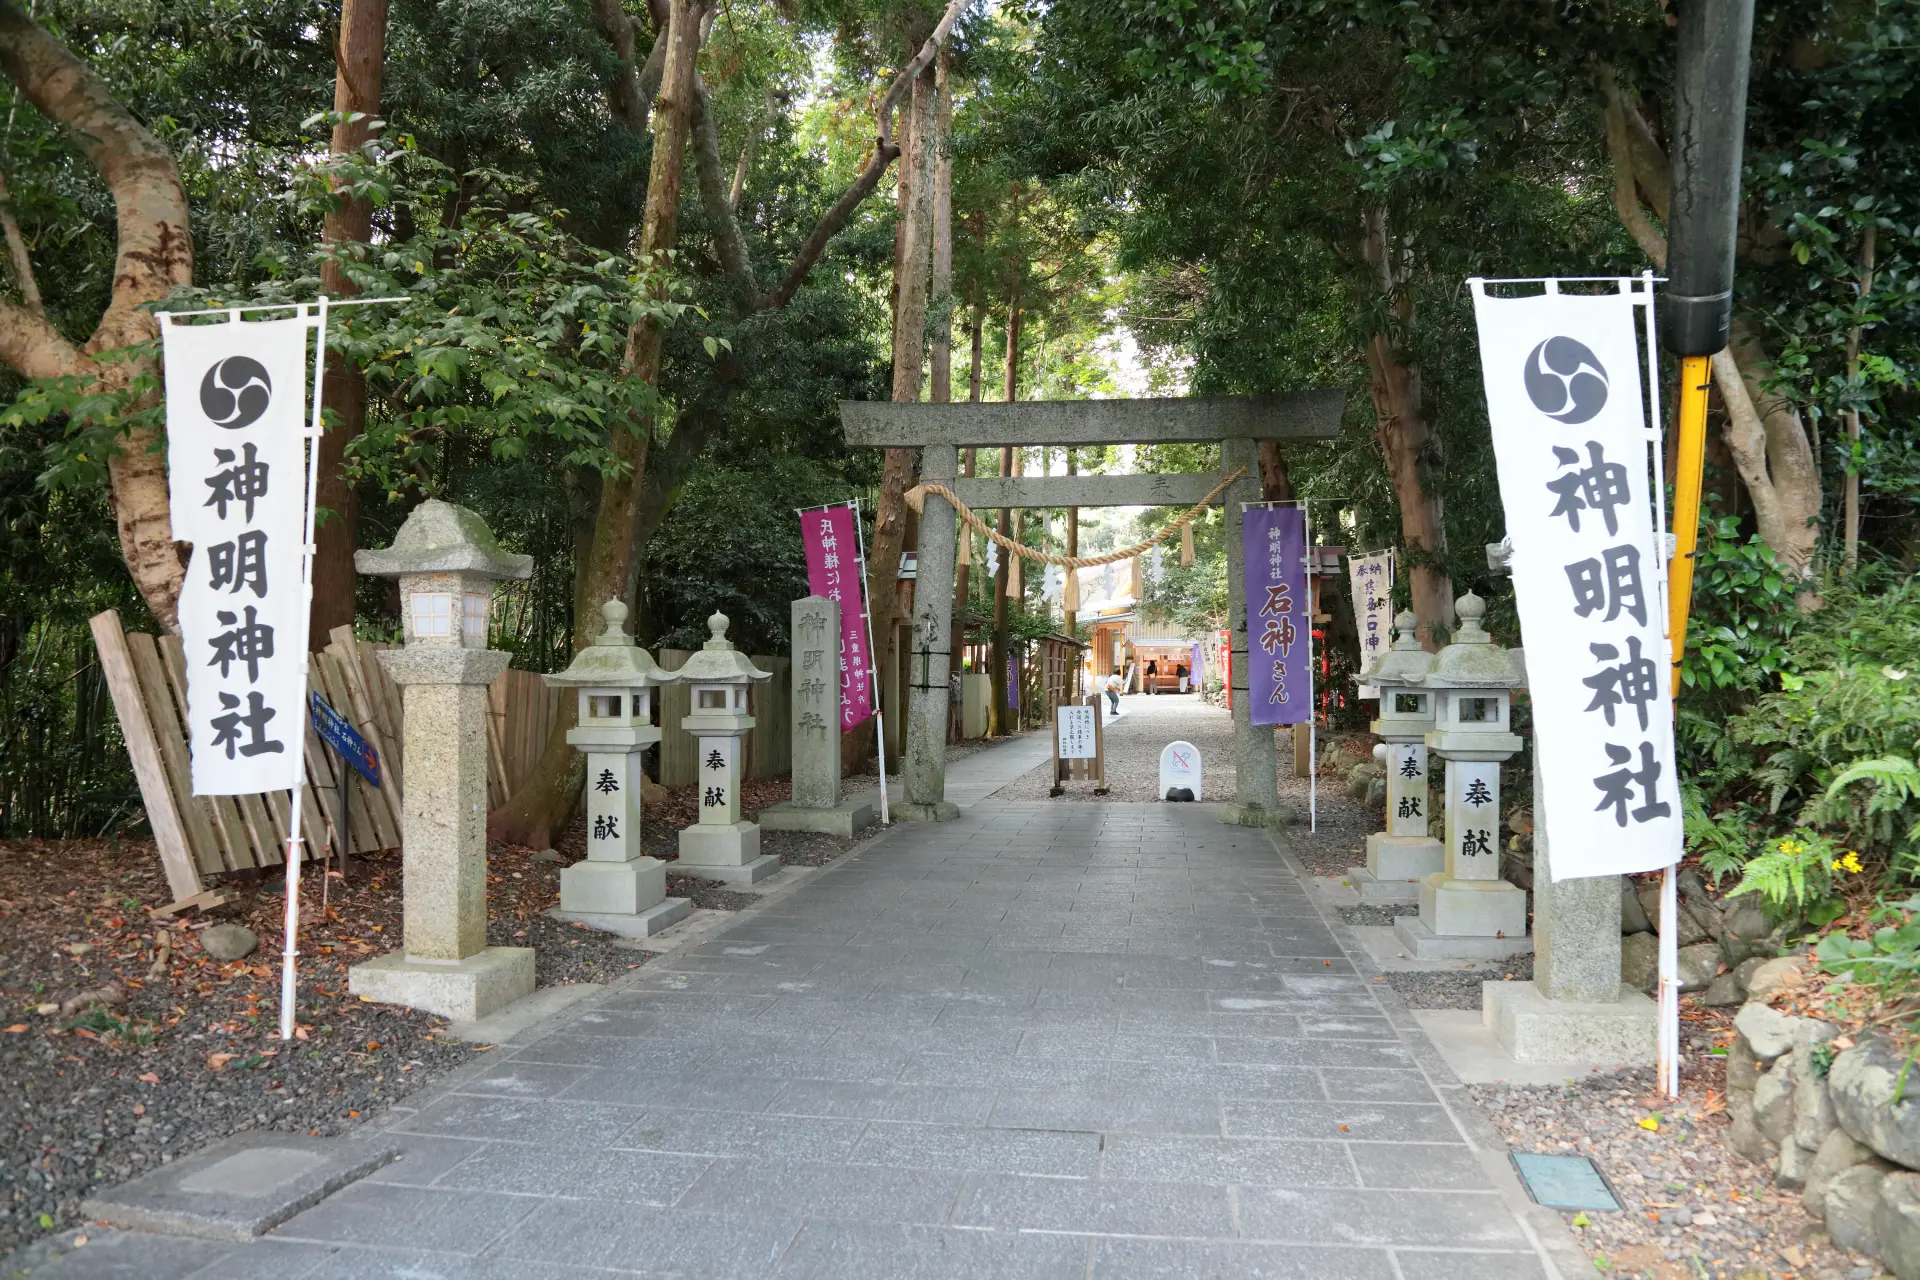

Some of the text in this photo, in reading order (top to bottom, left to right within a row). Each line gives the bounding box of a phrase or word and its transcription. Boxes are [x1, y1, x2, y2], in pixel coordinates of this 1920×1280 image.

[1268, 526, 1283, 580] 神明神社
[1356, 562, 1381, 578] 奉納
[202, 441, 285, 761] 神明神社
[1545, 440, 1671, 828] 神明神社
[798, 611, 827, 738] 神明神社
[1259, 583, 1297, 704] 石神さん
[594, 768, 620, 841] 奉献
[705, 749, 726, 808] 奉献
[1398, 756, 1423, 819] 奉献
[1462, 778, 1493, 857] 奉献
